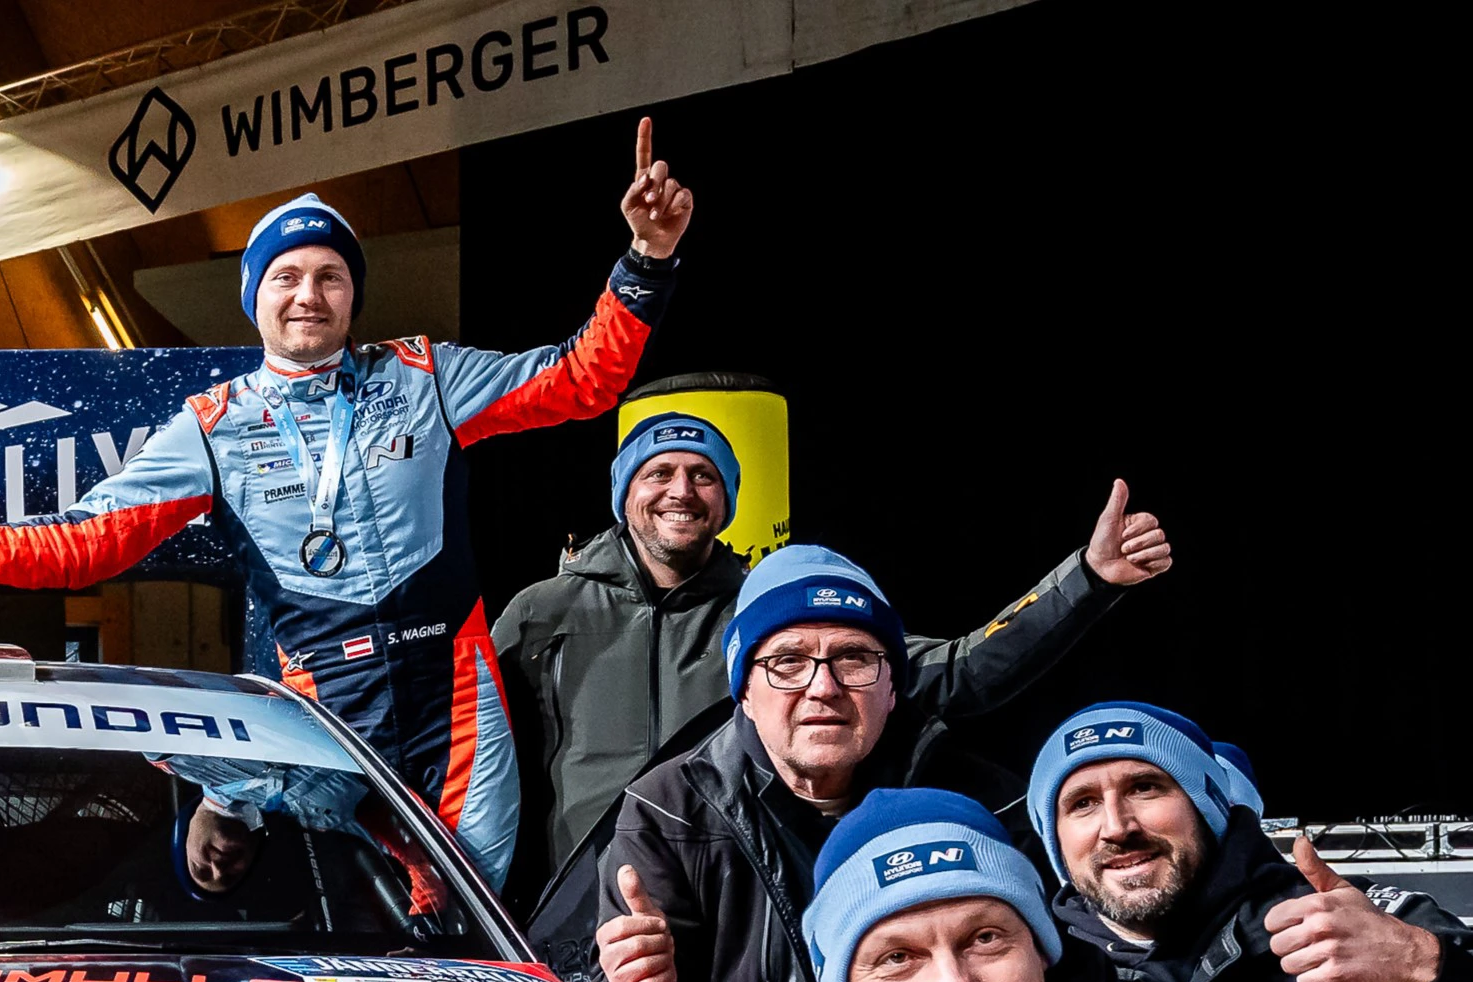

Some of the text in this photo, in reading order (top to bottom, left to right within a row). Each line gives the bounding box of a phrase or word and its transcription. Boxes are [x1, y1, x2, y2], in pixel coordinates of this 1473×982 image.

[221, 5, 610, 157] WIMBERGER
[264, 483, 306, 501] PRAMME
[387, 622, 446, 644] S. WAGNER
[883, 859, 923, 878] HYUNDAI
